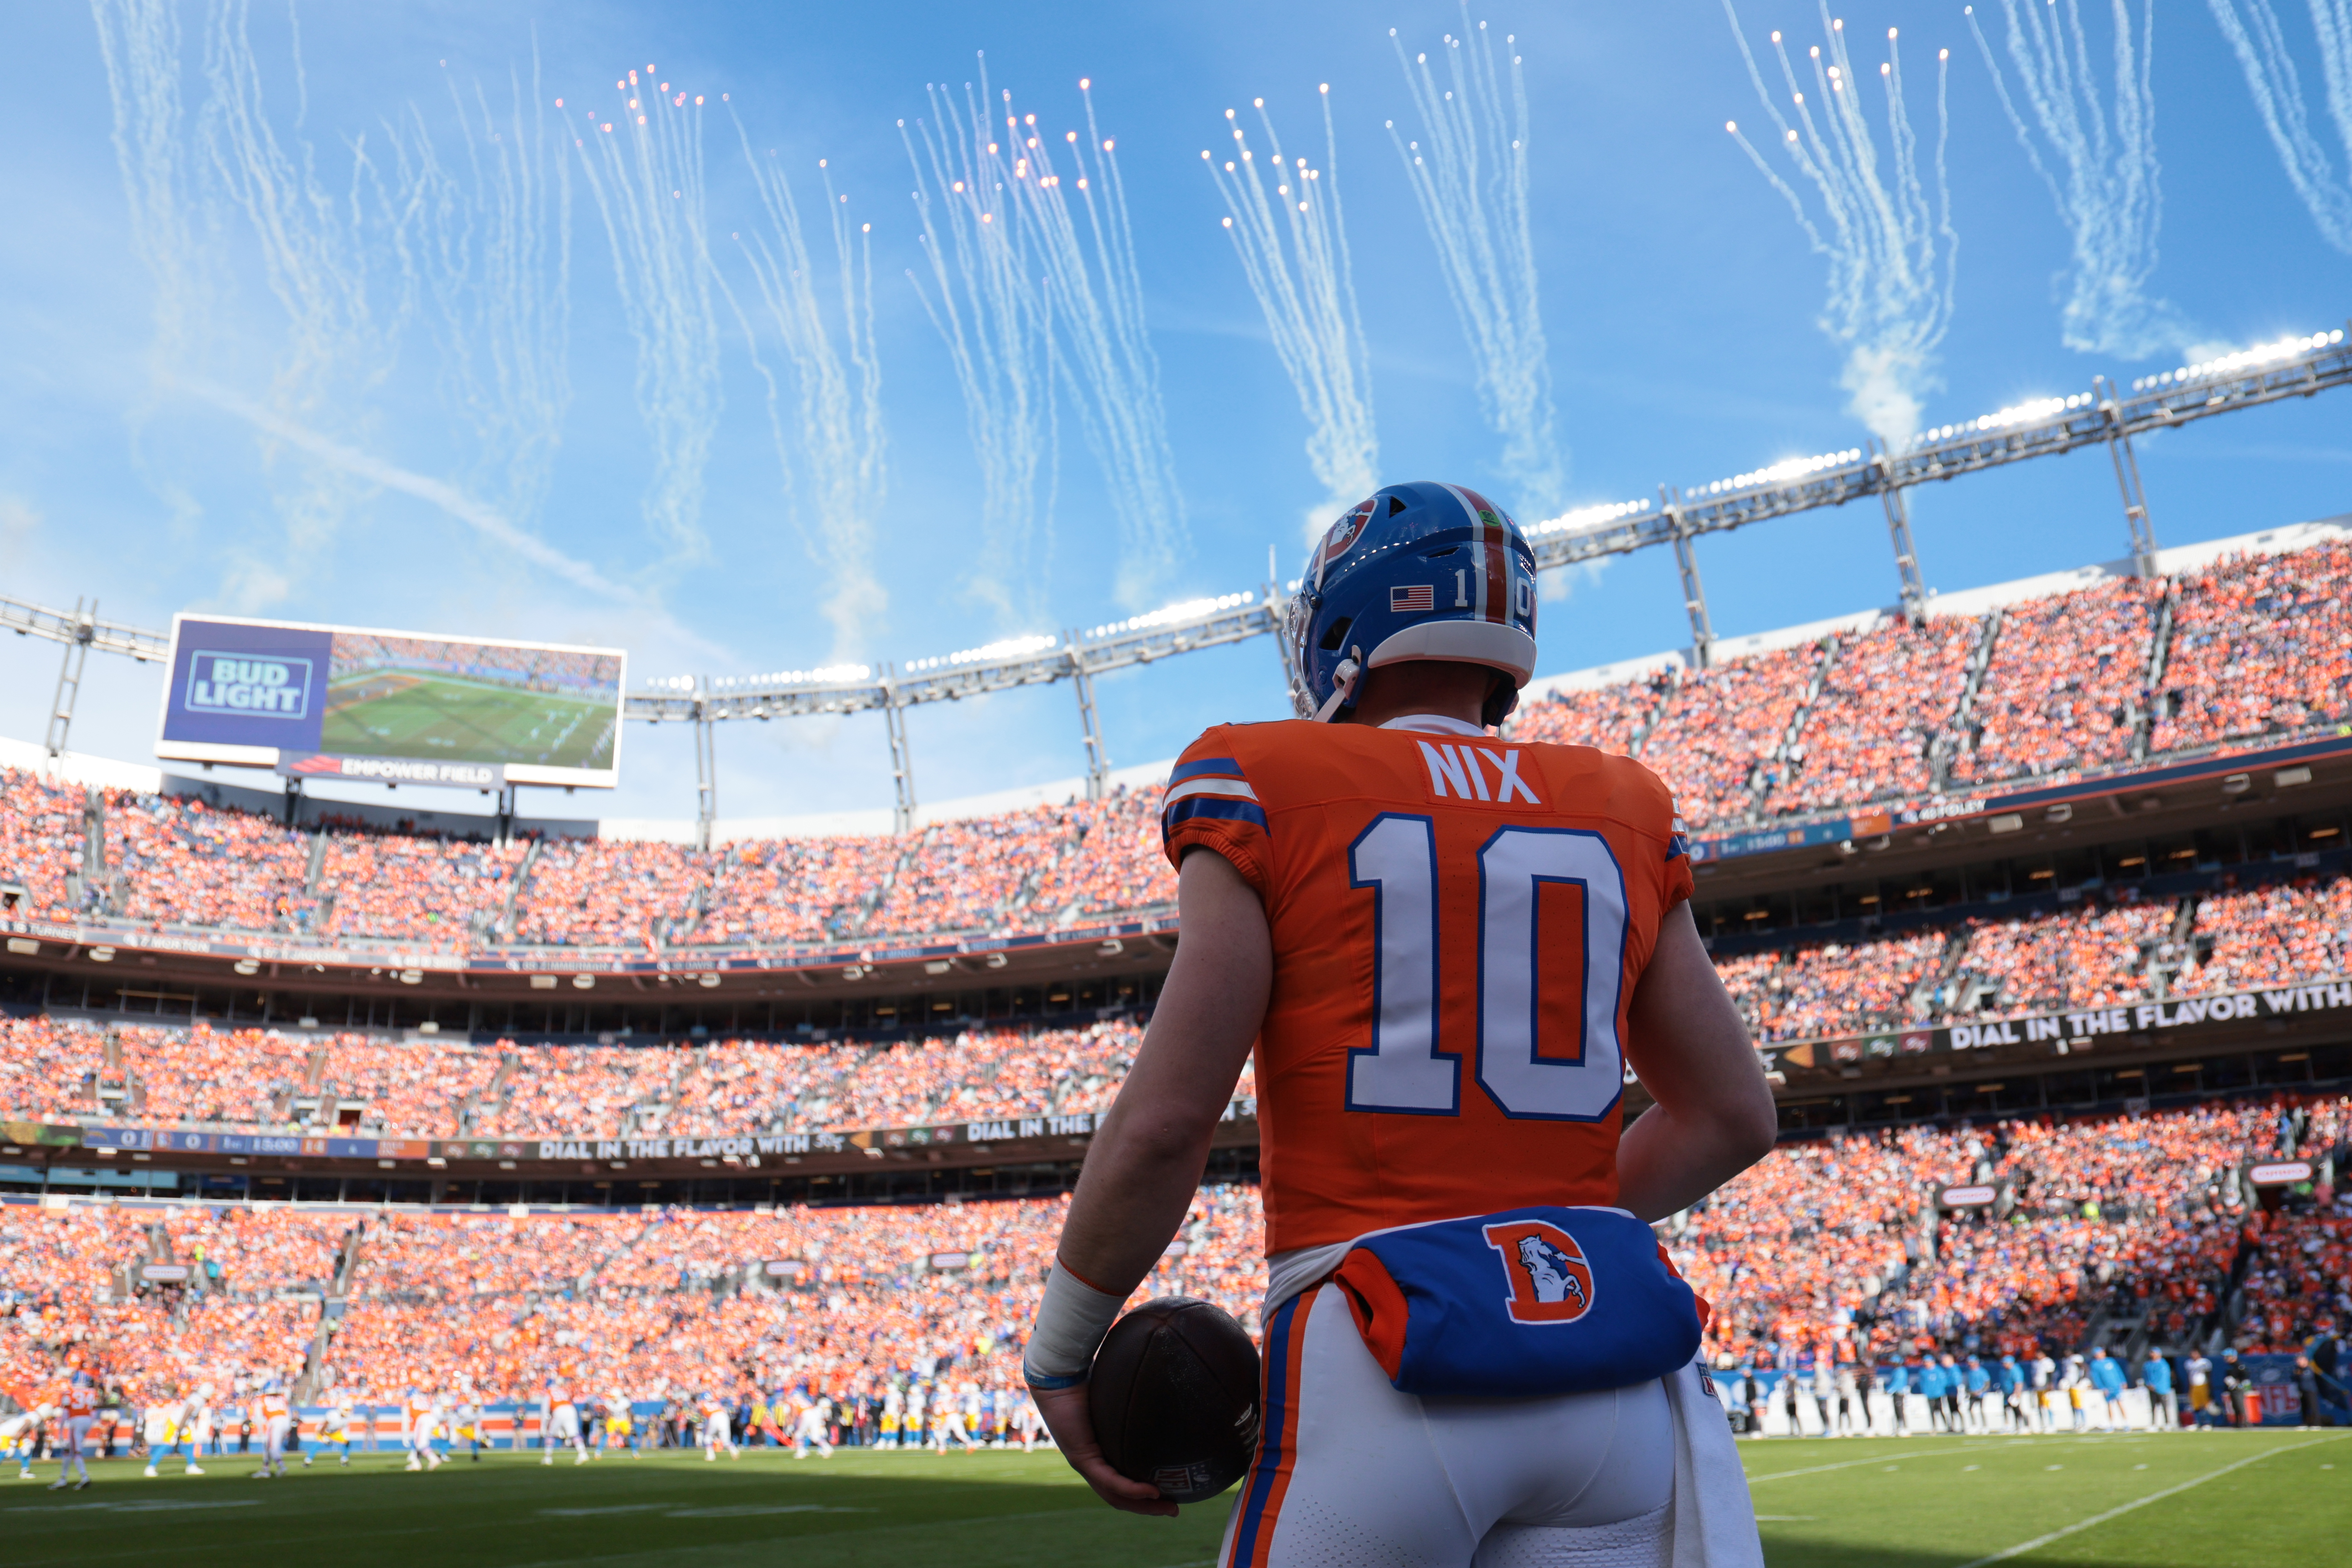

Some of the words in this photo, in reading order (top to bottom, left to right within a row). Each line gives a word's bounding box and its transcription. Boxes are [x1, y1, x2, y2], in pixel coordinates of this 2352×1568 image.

[1455, 569, 1468, 607] 1
[212, 658, 290, 687] BUD
[193, 680, 301, 712] LIGHT
[341, 758, 438, 781] EMPOWER
[439, 765, 494, 784] FIELD
[1416, 740, 1541, 804] NIX
[29, 923, 77, 940] TURNER
[151, 936, 210, 953] MORTON
[1344, 812, 1630, 1123] 10
[1949, 1021, 2021, 1050] DIAL
[2025, 1017, 2061, 1042] IN
[2066, 1008, 2130, 1037] THE
[2135, 994, 2258, 1030] FLAVOR
[2261, 981, 2352, 1014] WITH
[967, 1120, 1016, 1142] DIAL
[1019, 1118, 1043, 1138] IN
[1046, 1114, 1091, 1136] THE
[539, 1141, 593, 1160] DIAL
[597, 1141, 622, 1159] IN
[625, 1140, 670, 1159] THE
[673, 1137, 754, 1157] FLAVOR
[756, 1134, 810, 1154] WITH
